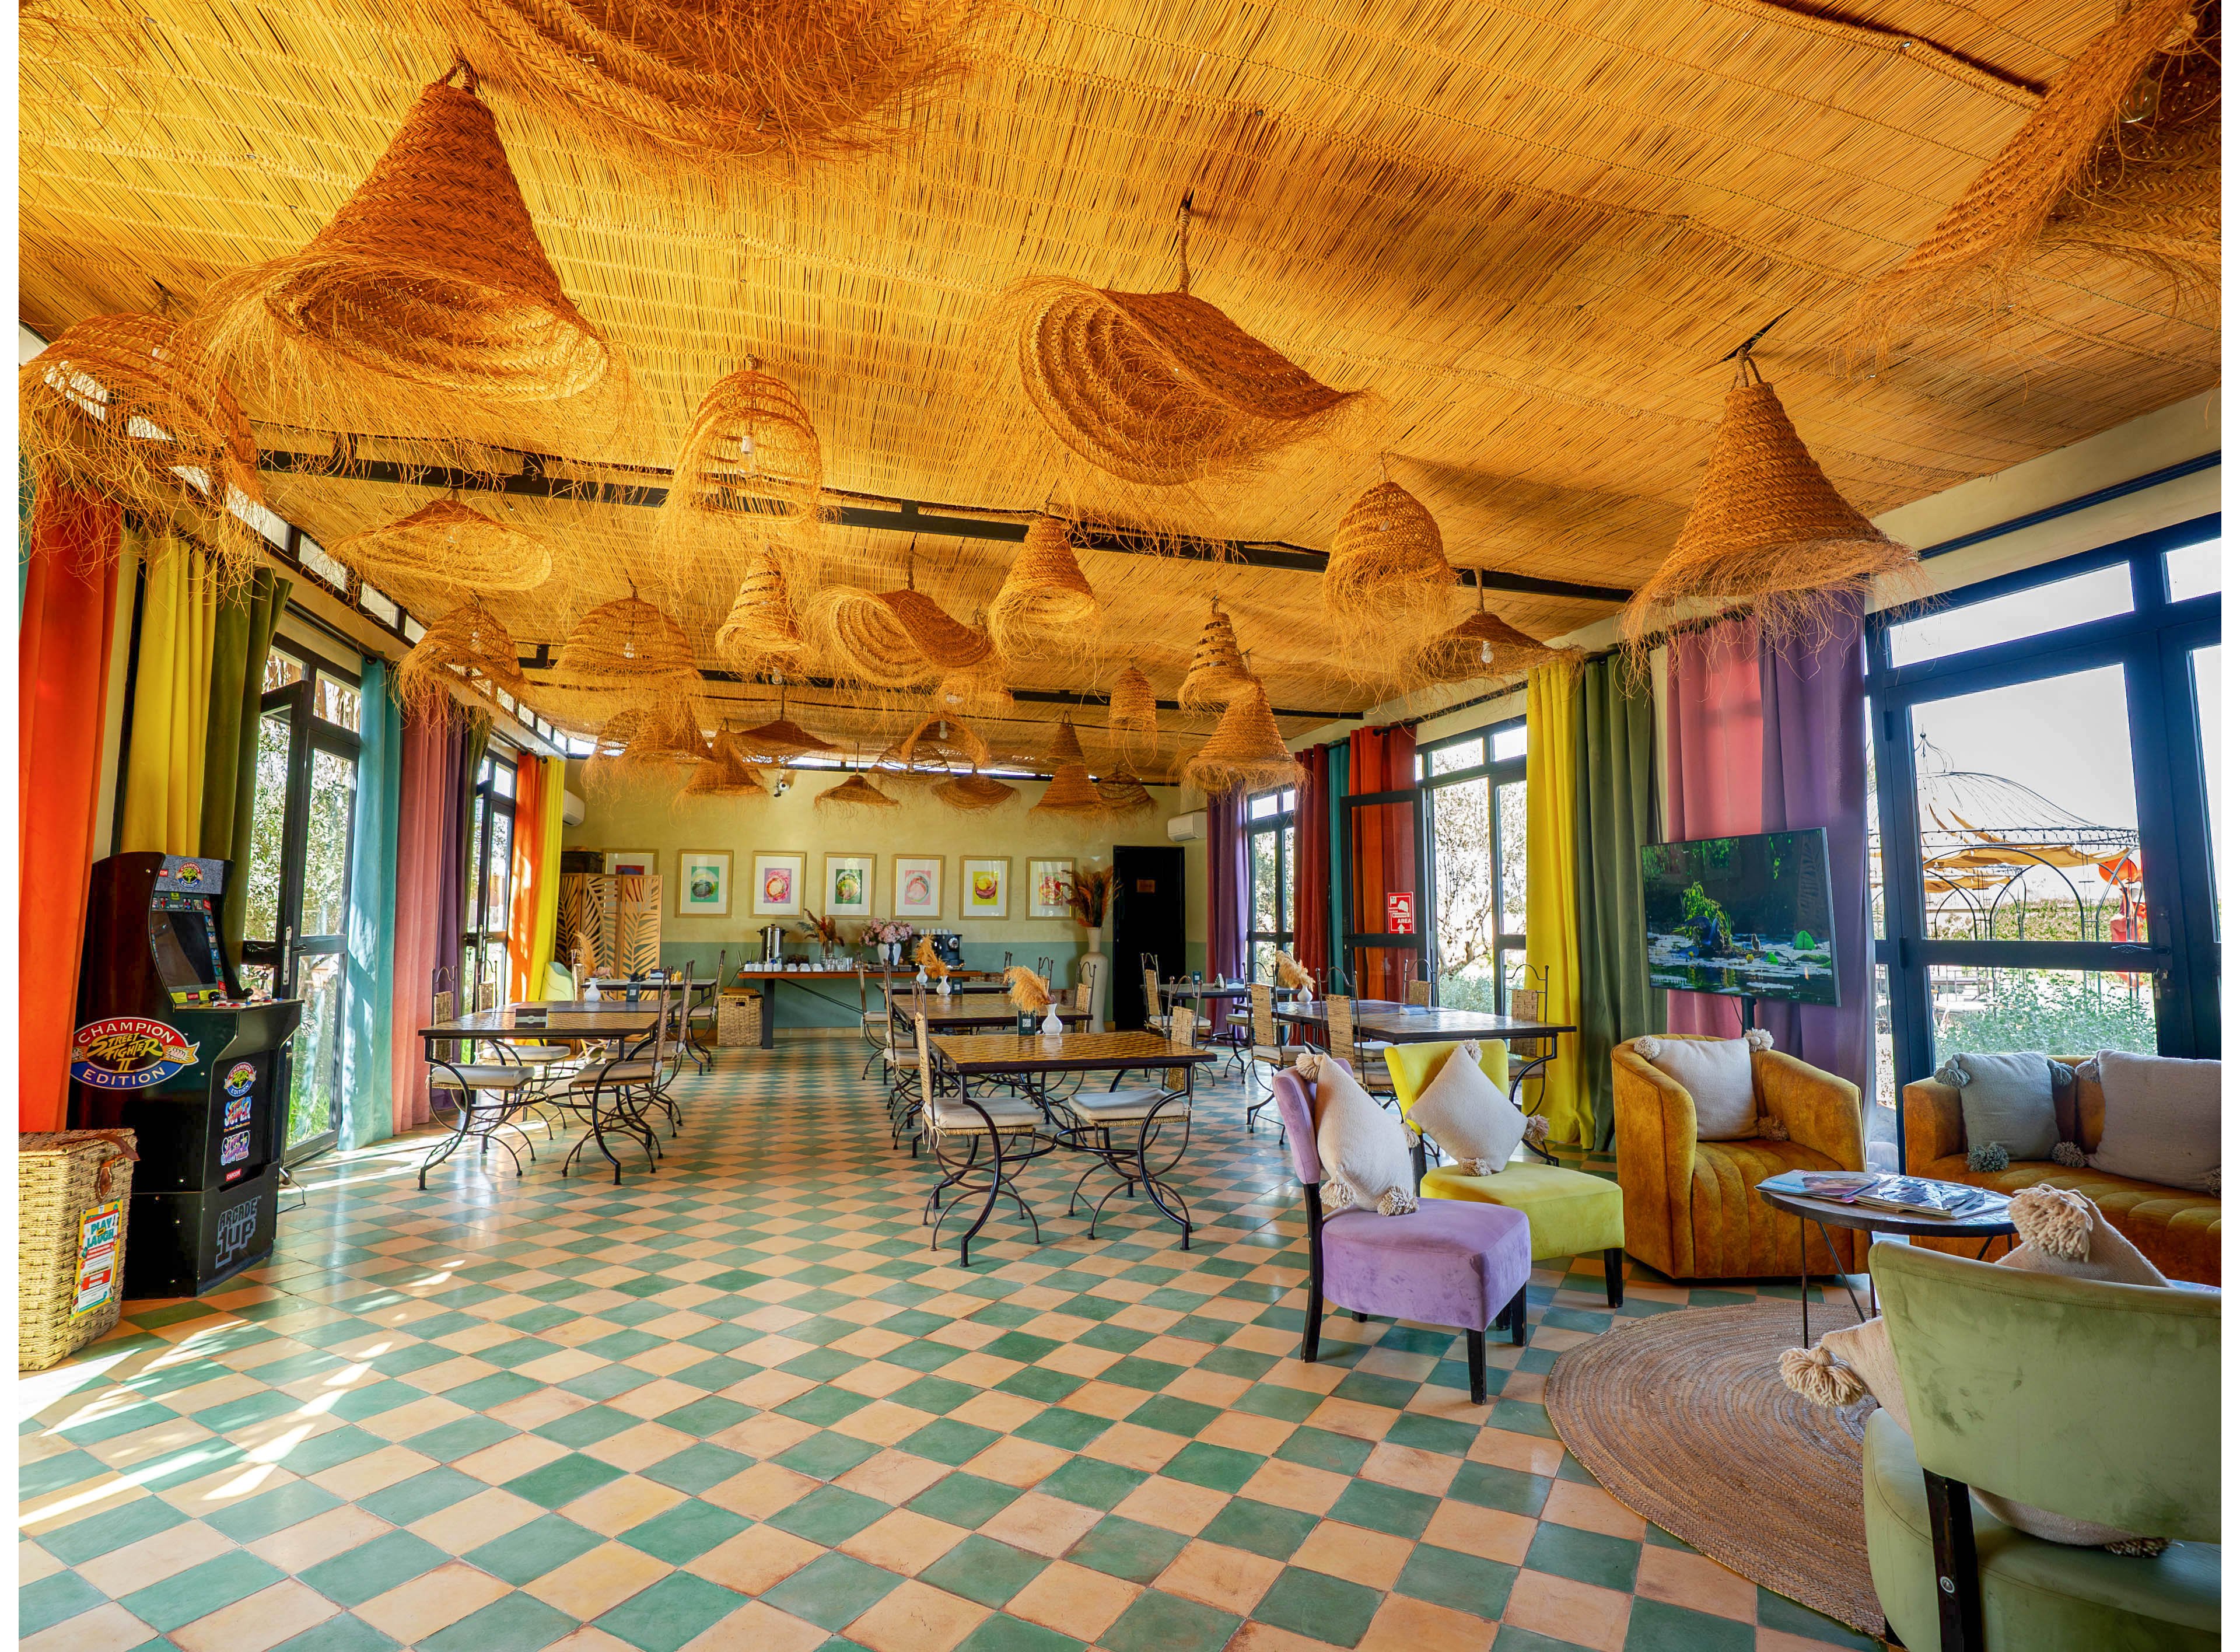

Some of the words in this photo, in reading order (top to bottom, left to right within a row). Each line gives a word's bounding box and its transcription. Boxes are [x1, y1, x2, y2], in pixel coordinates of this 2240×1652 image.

[78, 1022, 174, 1044] CHAMPION
[87, 1032, 140, 1057] STREET
[97, 1038, 164, 1060] FIGHTER
[82, 1067, 166, 1086] EDITION
[218, 1197, 258, 1232] ARCADE
[90, 1217, 113, 1235] PLAY
[87, 1228, 114, 1248] LAUGH
